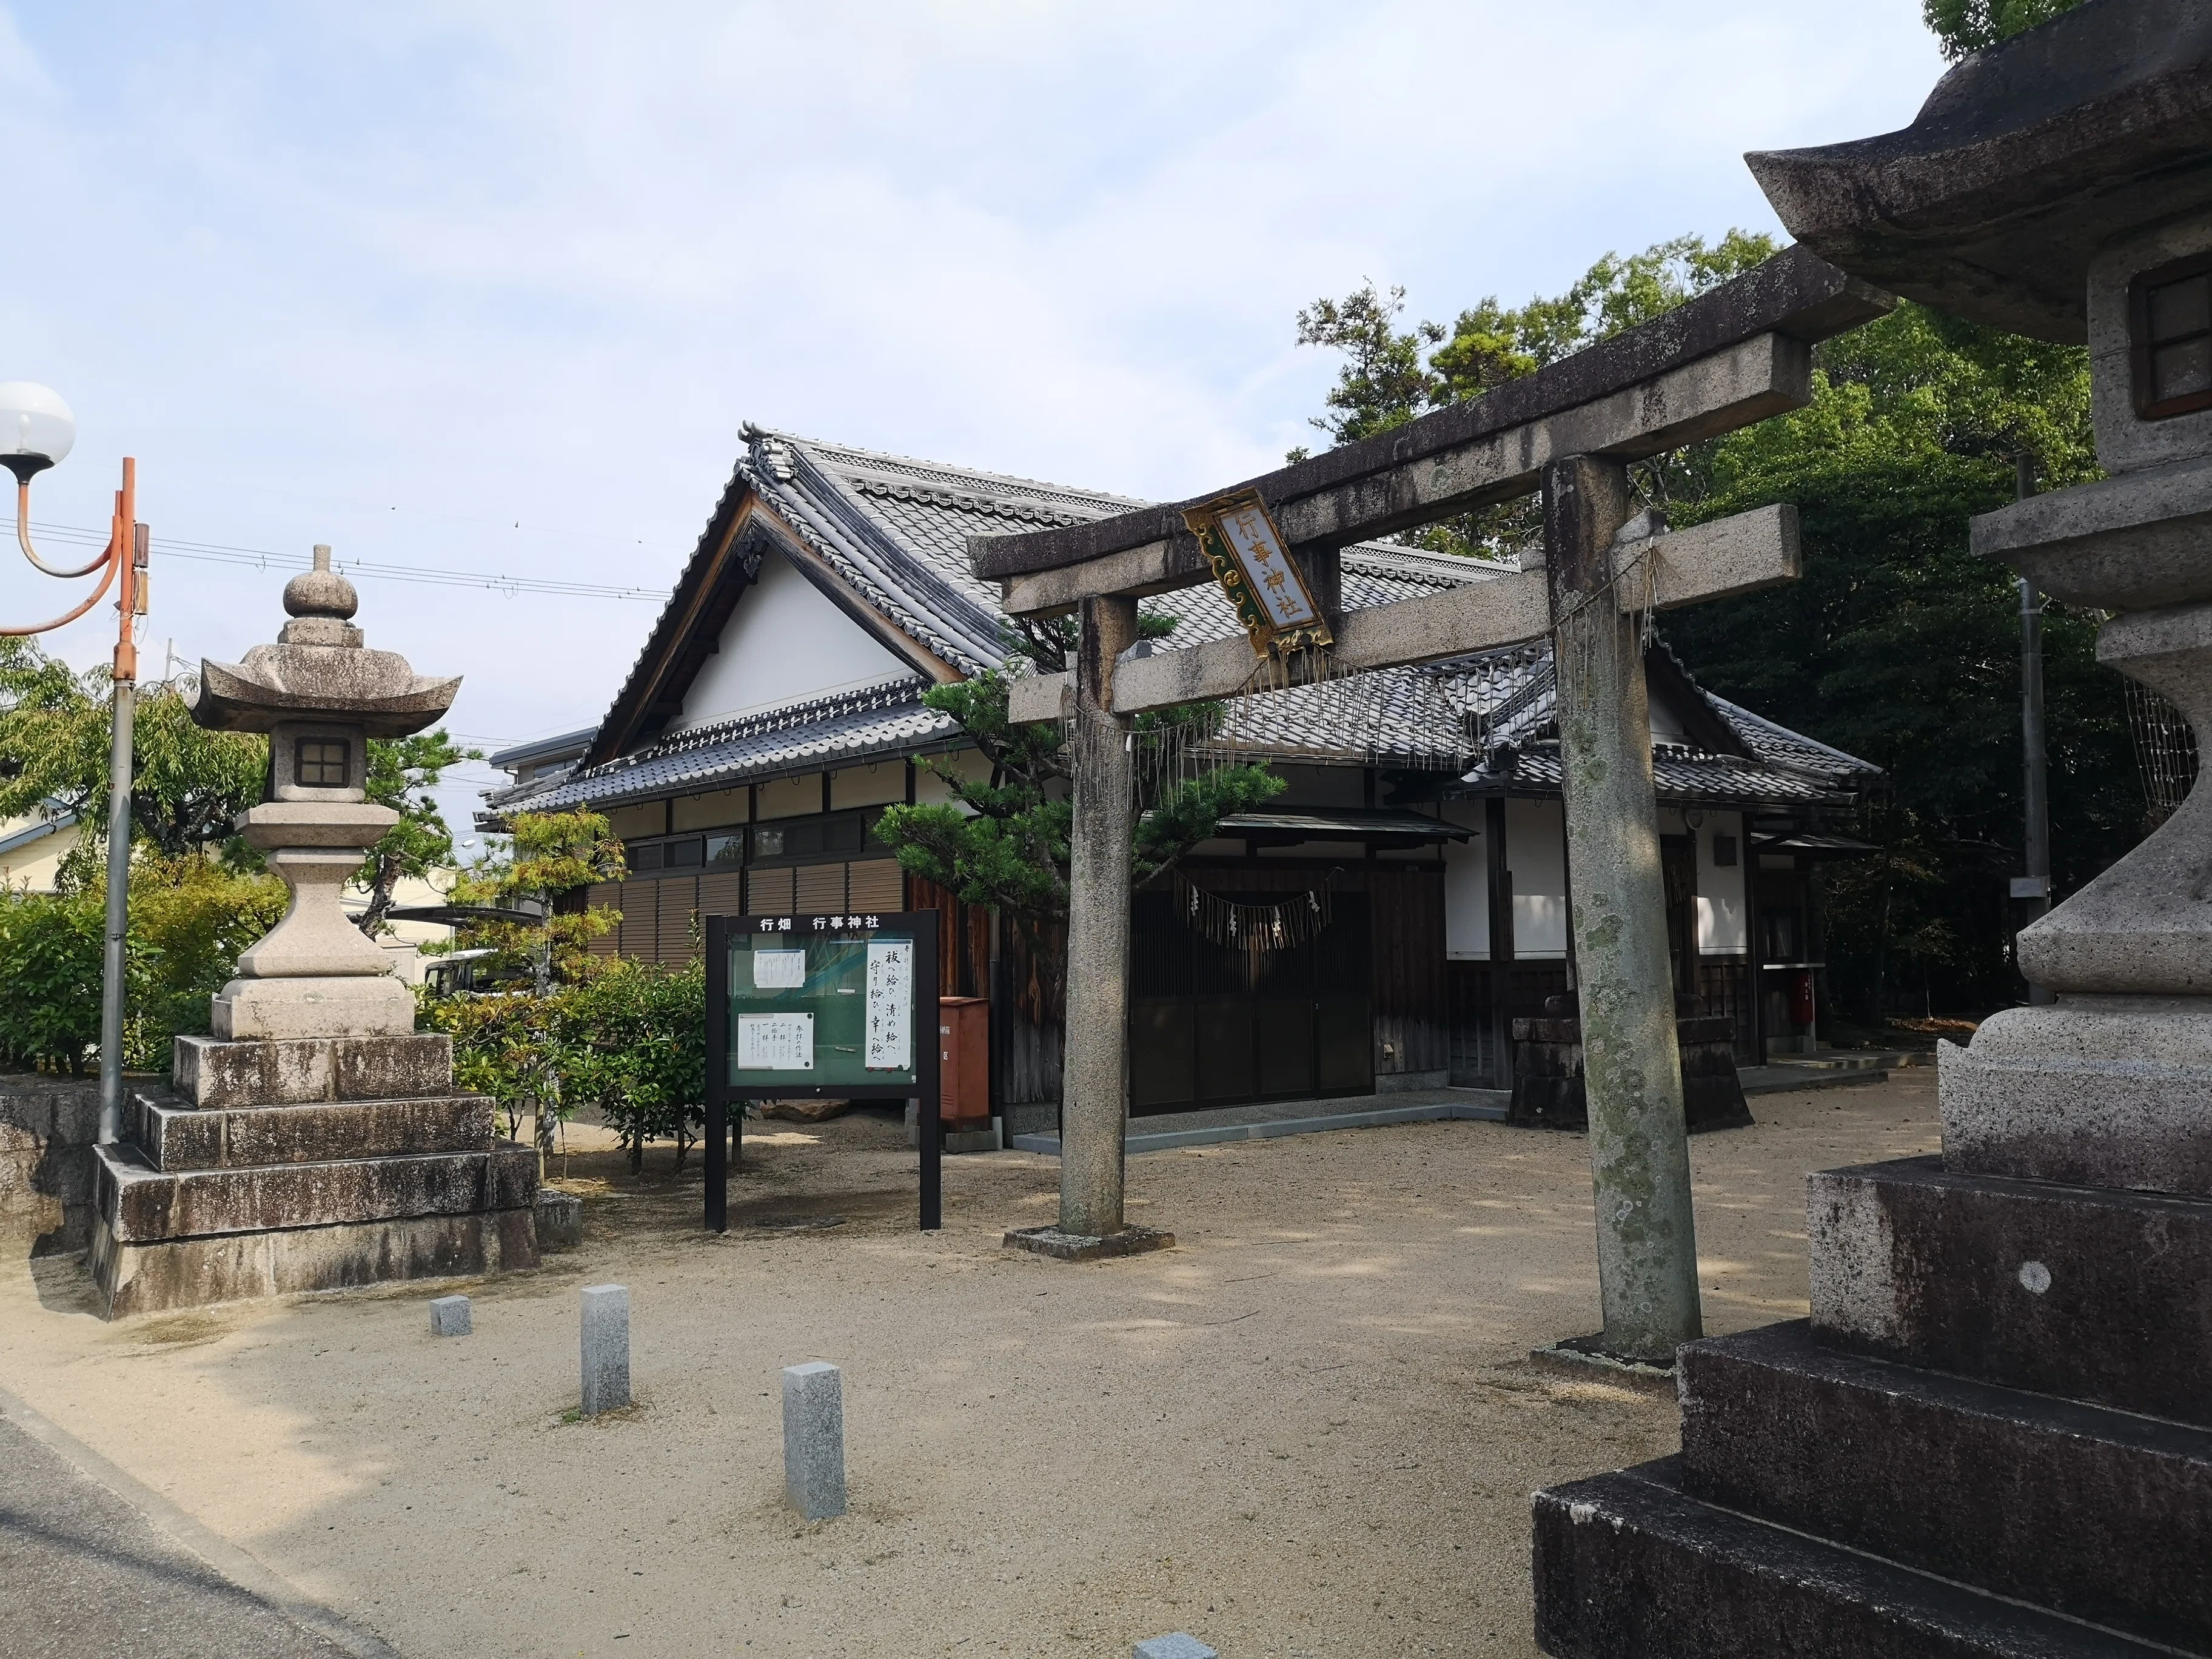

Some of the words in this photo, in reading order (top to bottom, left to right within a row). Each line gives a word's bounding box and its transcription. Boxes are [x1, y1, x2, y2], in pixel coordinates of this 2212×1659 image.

[1234, 512, 1303, 619] 行事神社
[760, 917, 791, 931] 行畑
[813, 915, 880, 930] 行事神社
[794, 1024, 803, 1058] 参拝の作法
